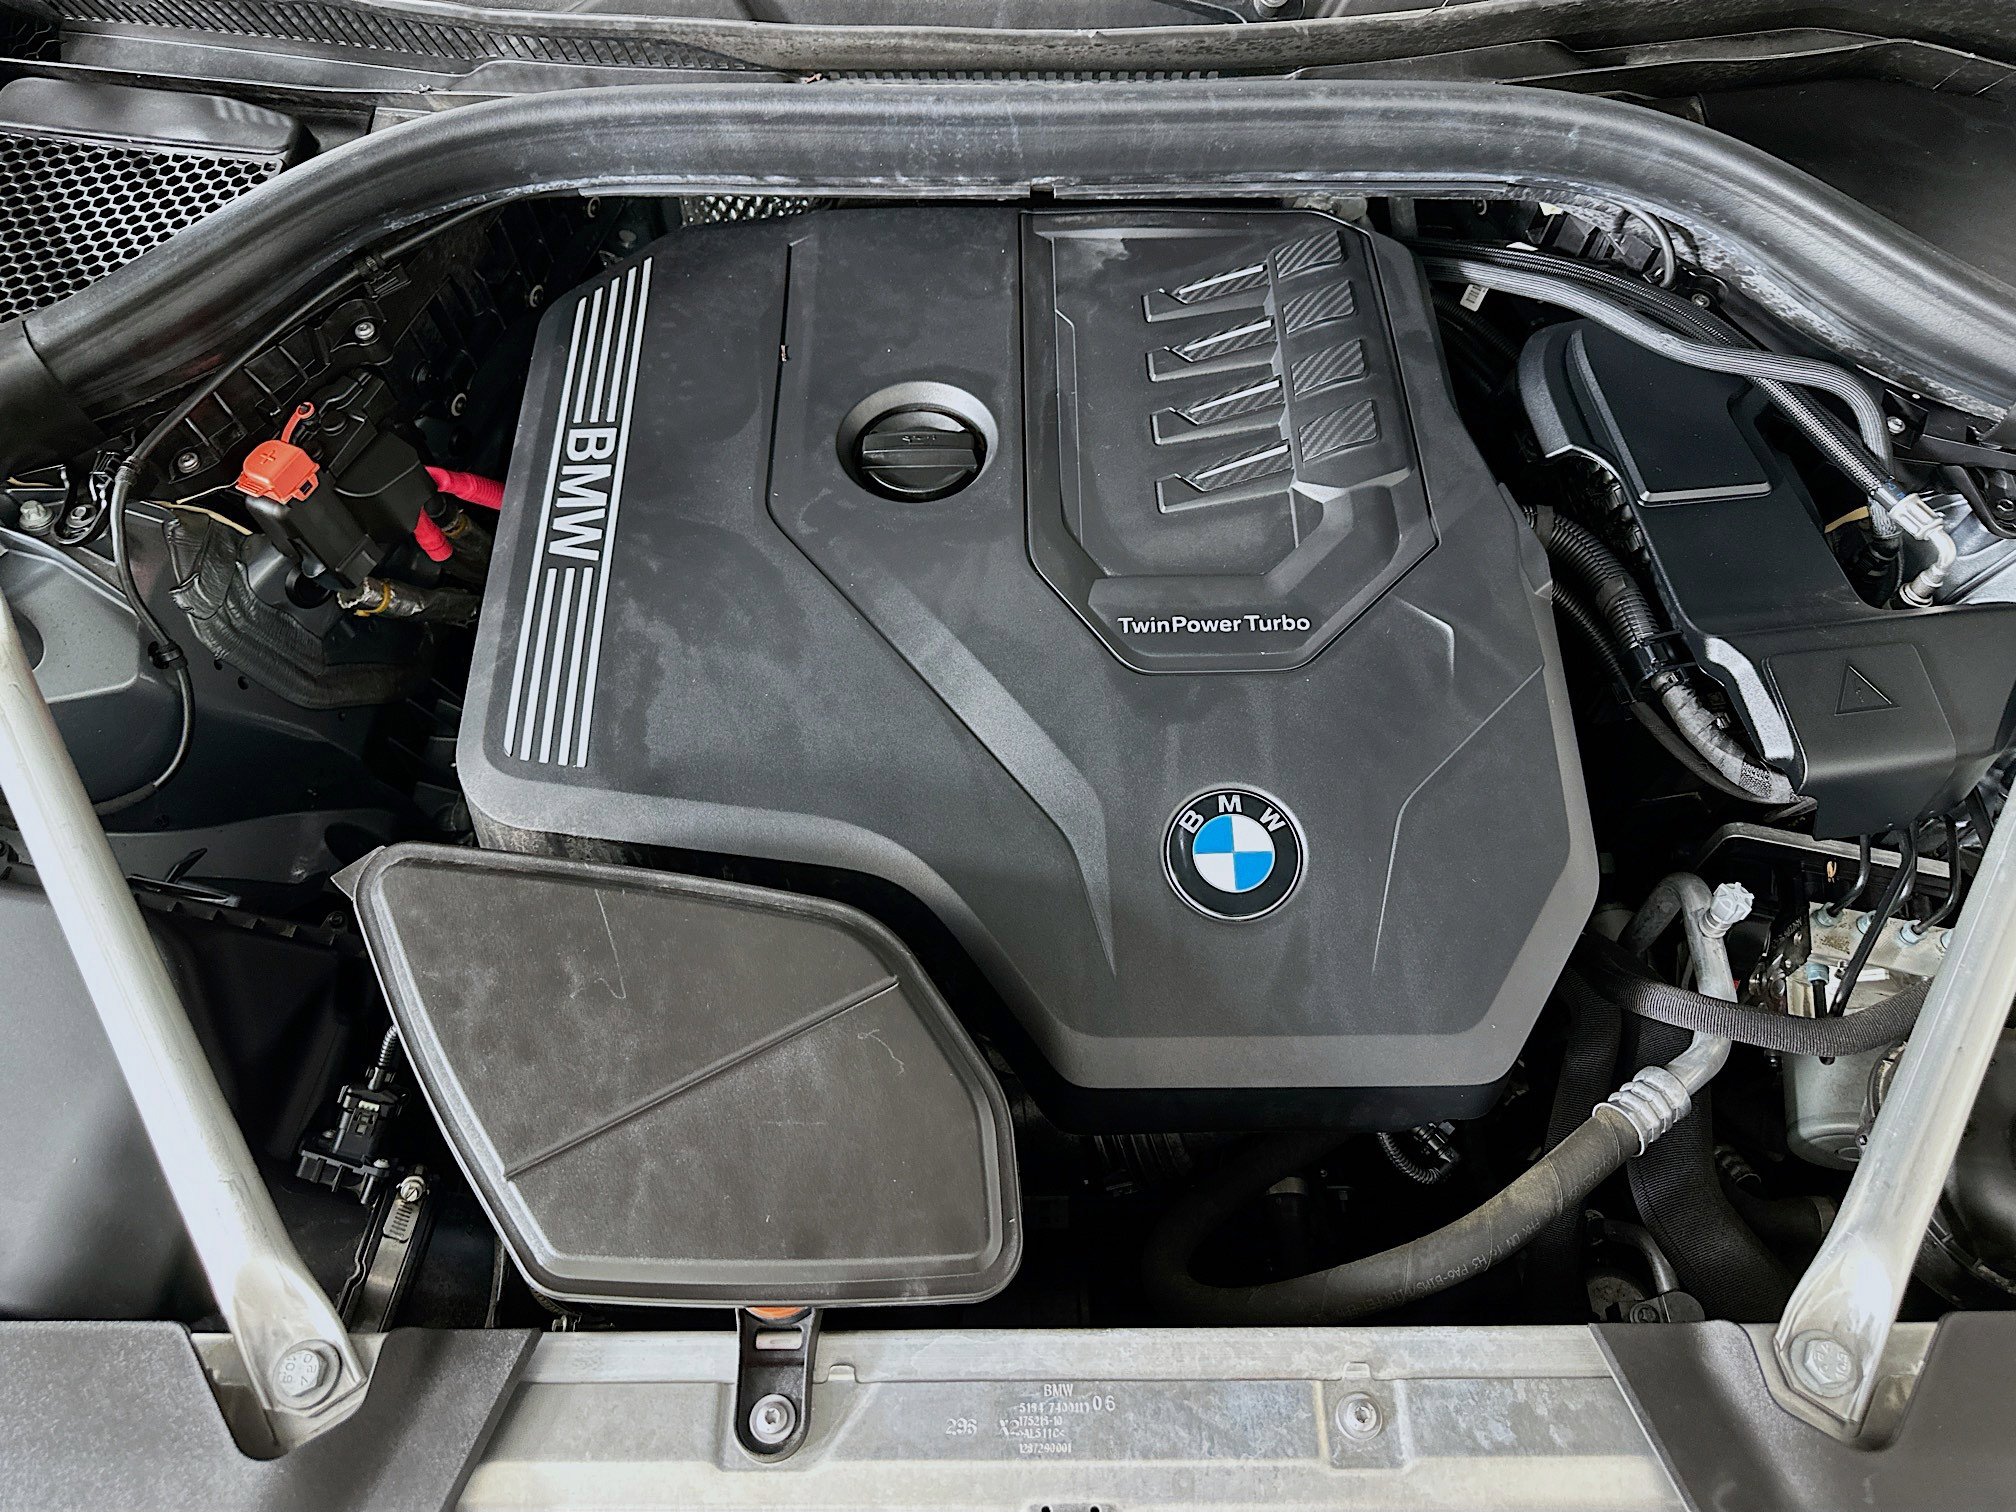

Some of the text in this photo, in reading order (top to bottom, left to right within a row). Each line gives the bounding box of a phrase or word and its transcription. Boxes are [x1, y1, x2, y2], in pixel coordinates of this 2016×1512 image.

[549, 428, 617, 561] BMW
[1118, 614, 1311, 634] TwinPower Turbo
[1179, 795, 1286, 834] BMW
[1043, 1384, 1074, 1397] BMW
[1092, 1395, 1116, 1413] 06
